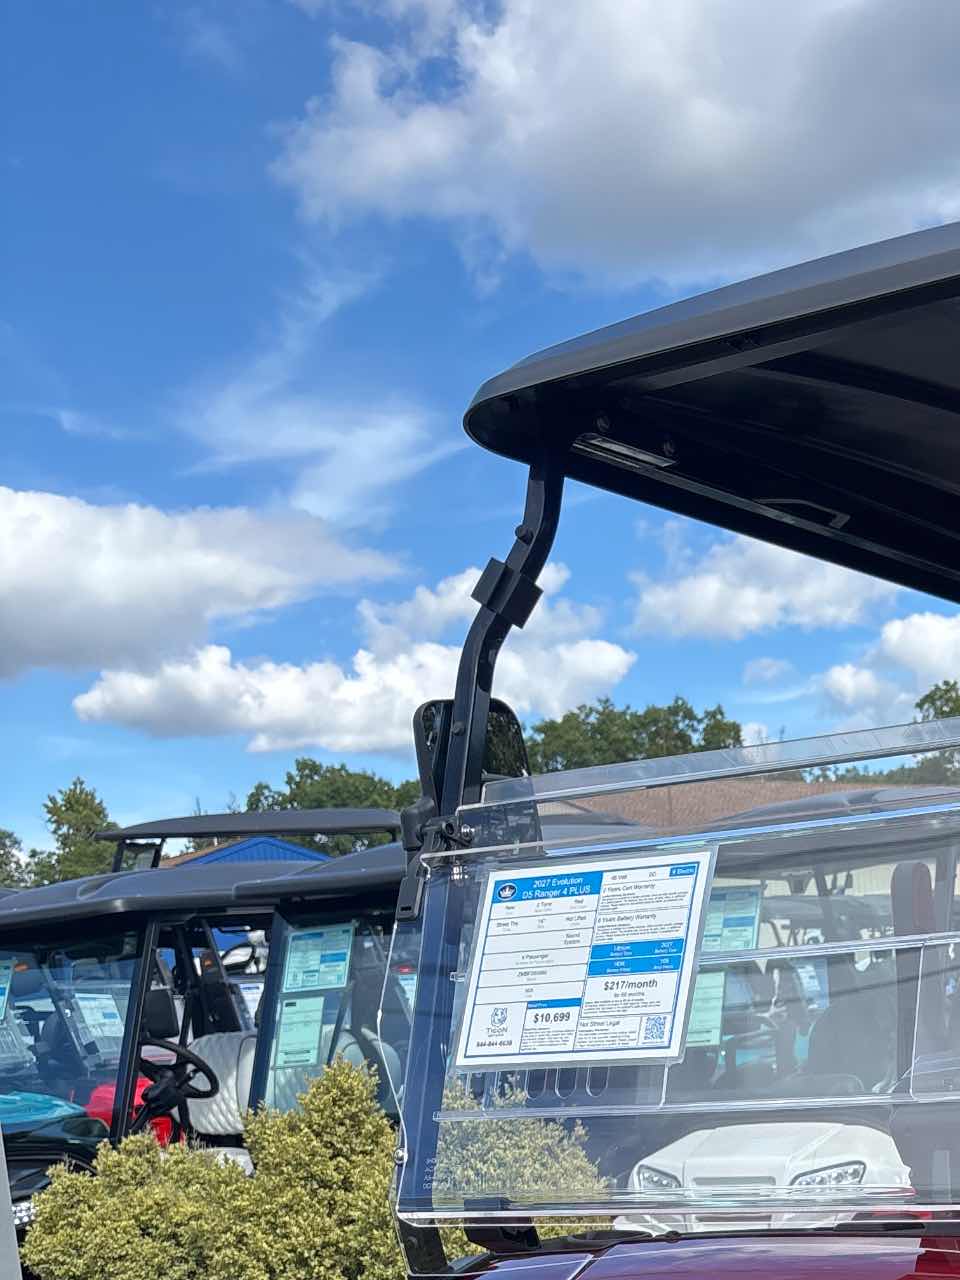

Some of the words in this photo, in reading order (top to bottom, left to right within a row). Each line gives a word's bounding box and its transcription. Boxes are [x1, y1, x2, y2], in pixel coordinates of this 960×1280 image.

[533, 879, 550, 889] 2027
[551, 877, 583, 887] Evolution
[534, 888, 561, 899] Ranger
[562, 887, 568, 895] 4
[569, 885, 591, 895] PLUS
[604, 979, 658, 991] $217/month
[533, 1011, 571, 1024] $10,699
